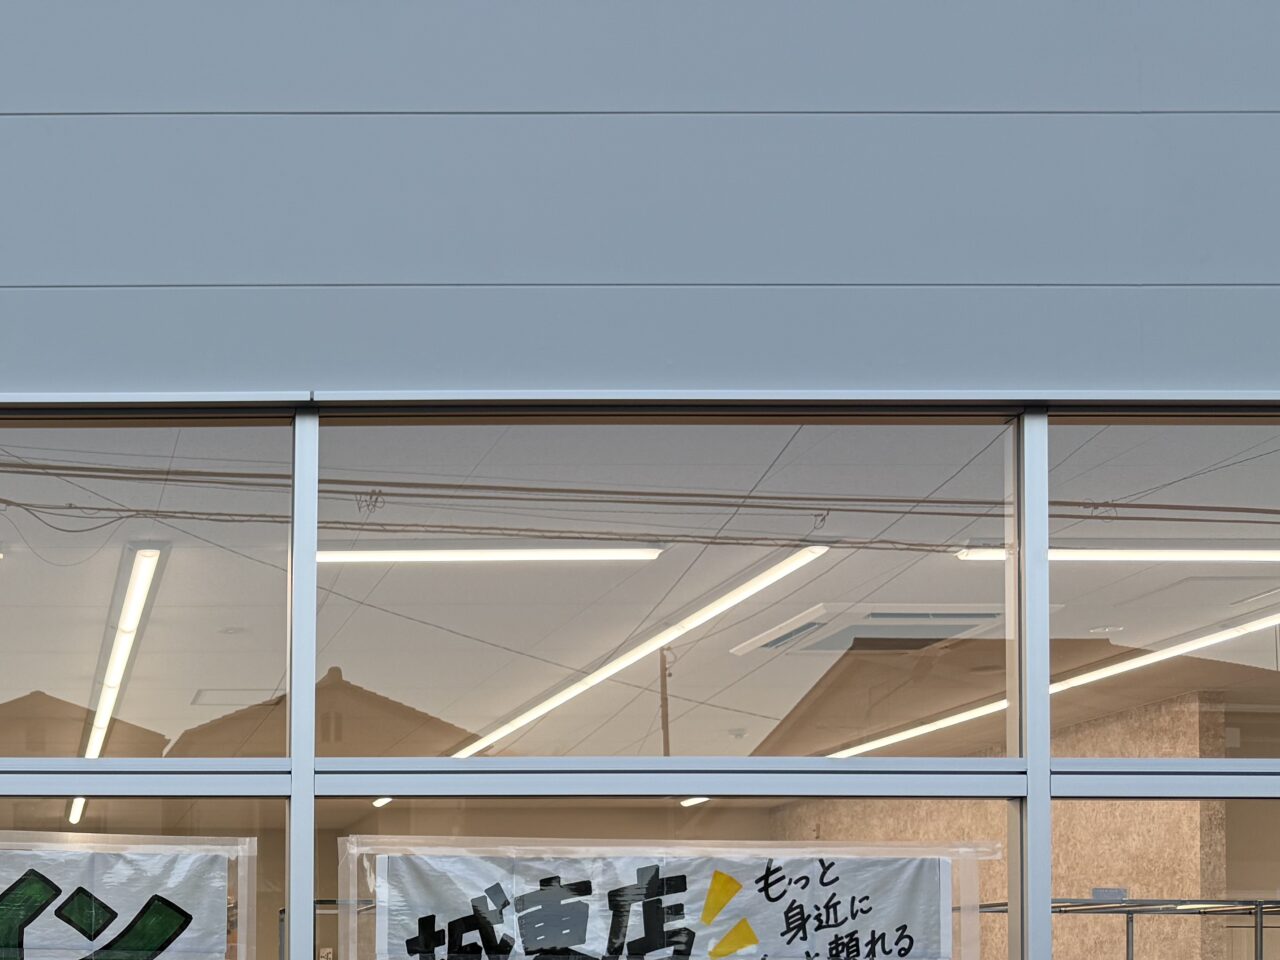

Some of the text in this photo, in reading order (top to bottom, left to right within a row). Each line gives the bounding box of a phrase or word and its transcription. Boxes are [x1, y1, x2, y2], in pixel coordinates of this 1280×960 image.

[755, 858, 839, 902] もっと
[780, 892, 872, 945] 身近に
